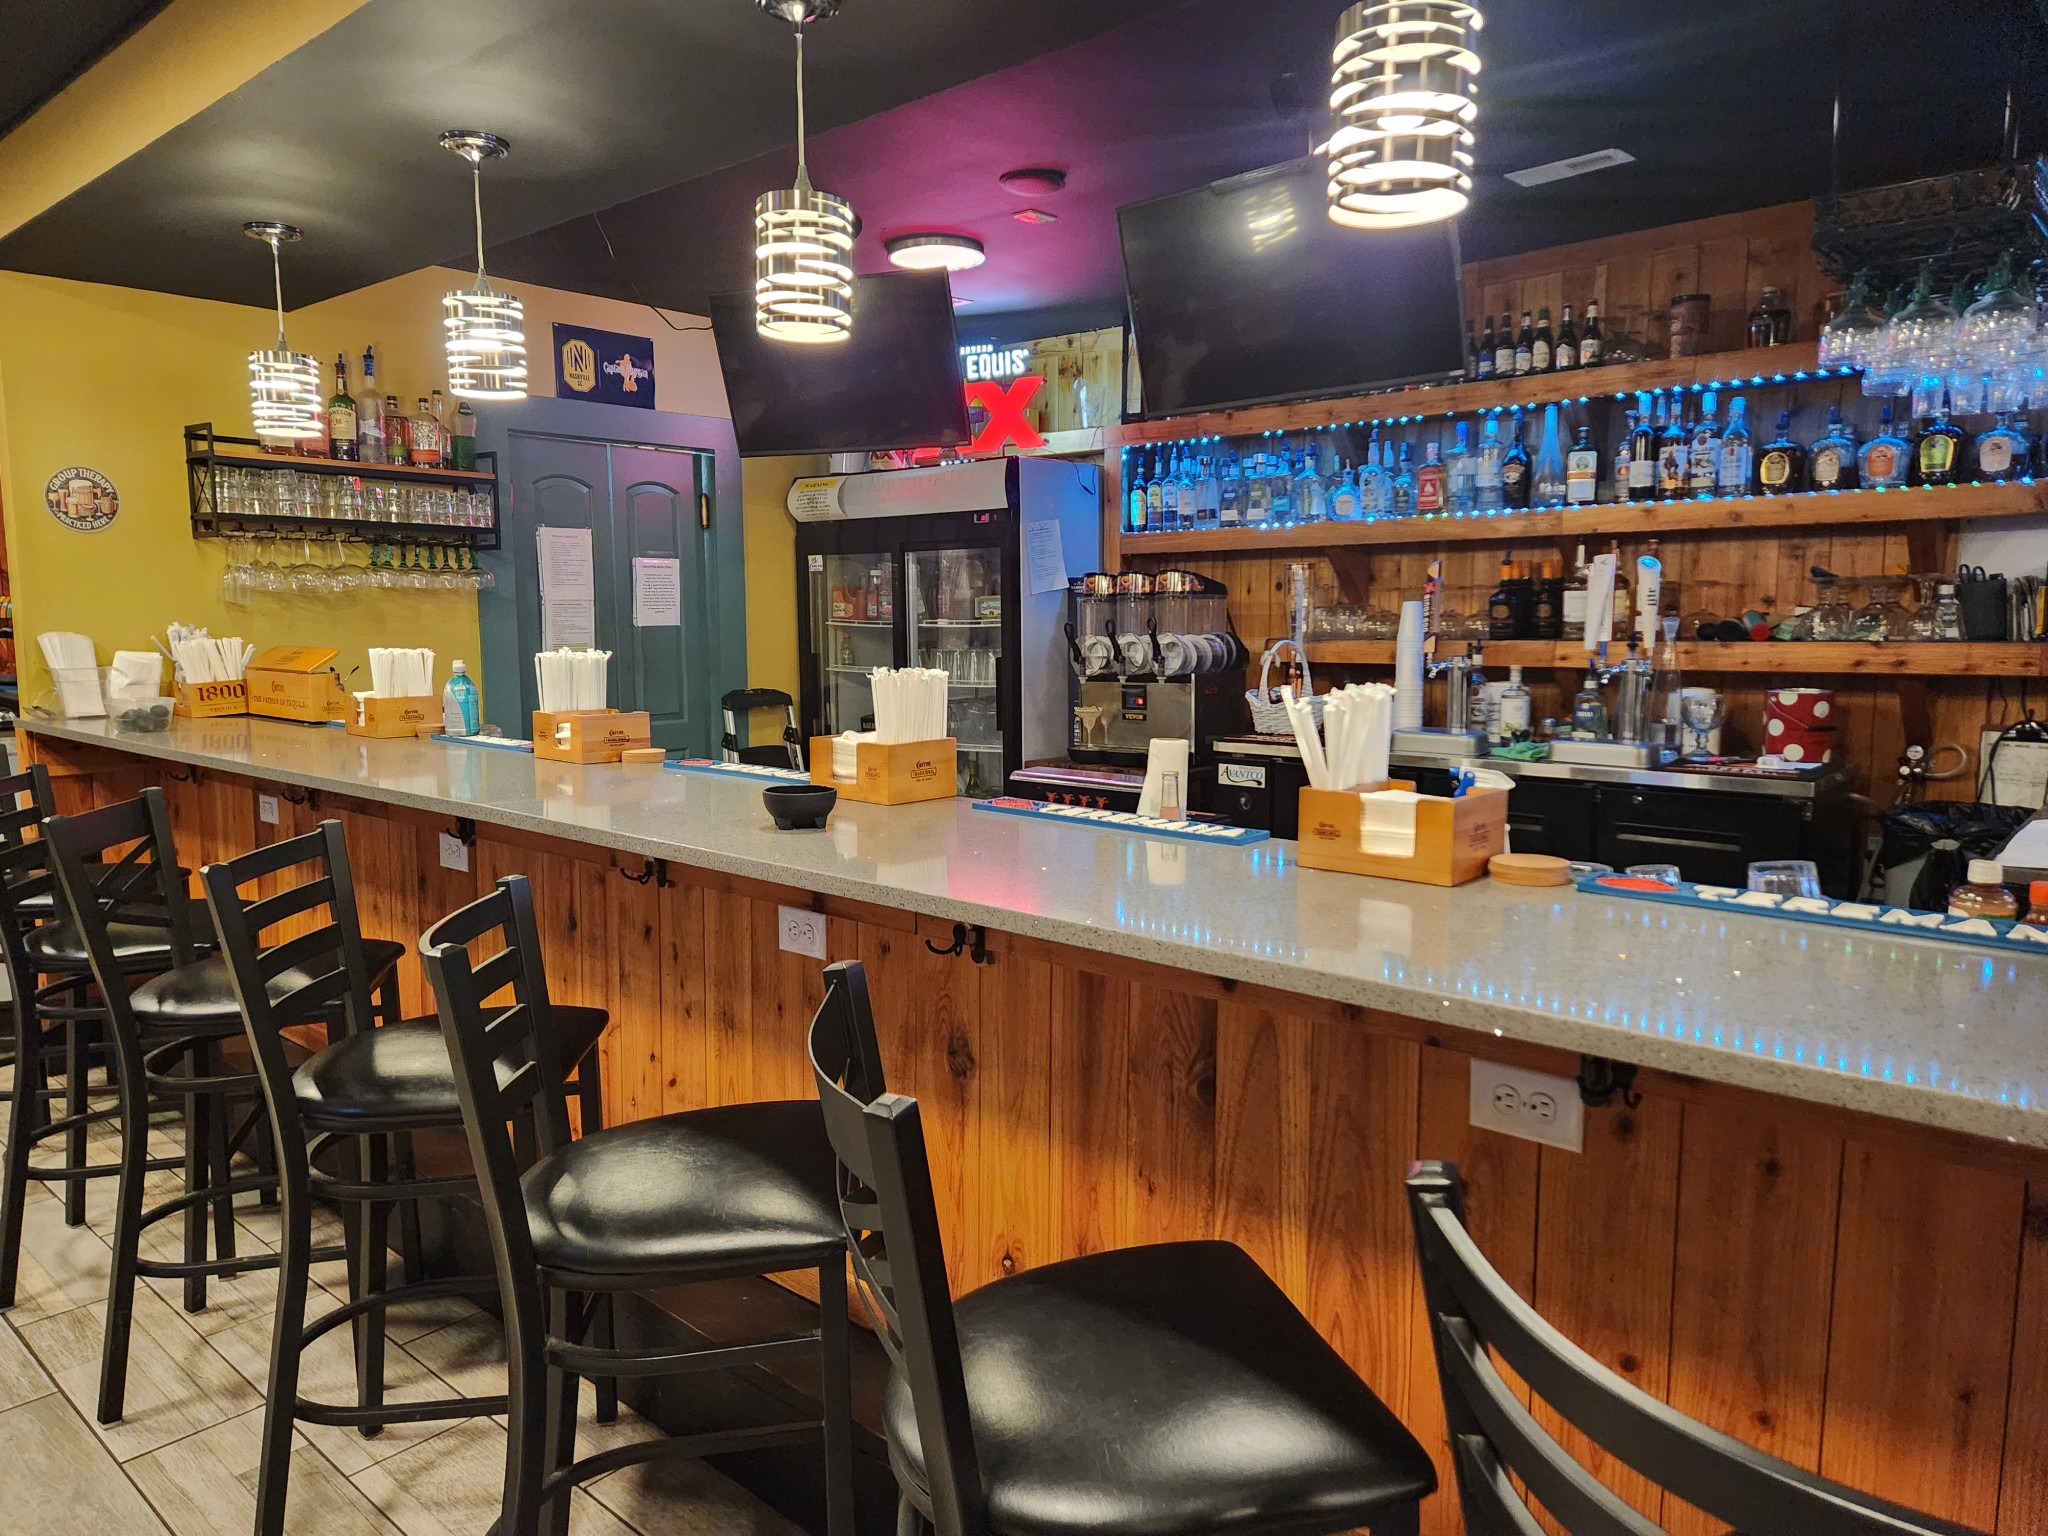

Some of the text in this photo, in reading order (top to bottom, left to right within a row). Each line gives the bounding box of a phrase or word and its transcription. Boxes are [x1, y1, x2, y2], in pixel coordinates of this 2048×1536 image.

[967, 350, 1026, 381] EQUIS
[569, 372, 590, 382] NASHVILLE
[330, 409, 352, 417] AMESON
[50, 468, 114, 494] GROUP THERAPY
[57, 512, 110, 529] PRACTICED HERE
[197, 683, 246, 701] 1800
[253, 695, 262, 703] THE
[262, 696, 279, 705] FATHER
[286, 699, 307, 710] TEQUILA
[1220, 766, 1263, 782] AVANTCO
